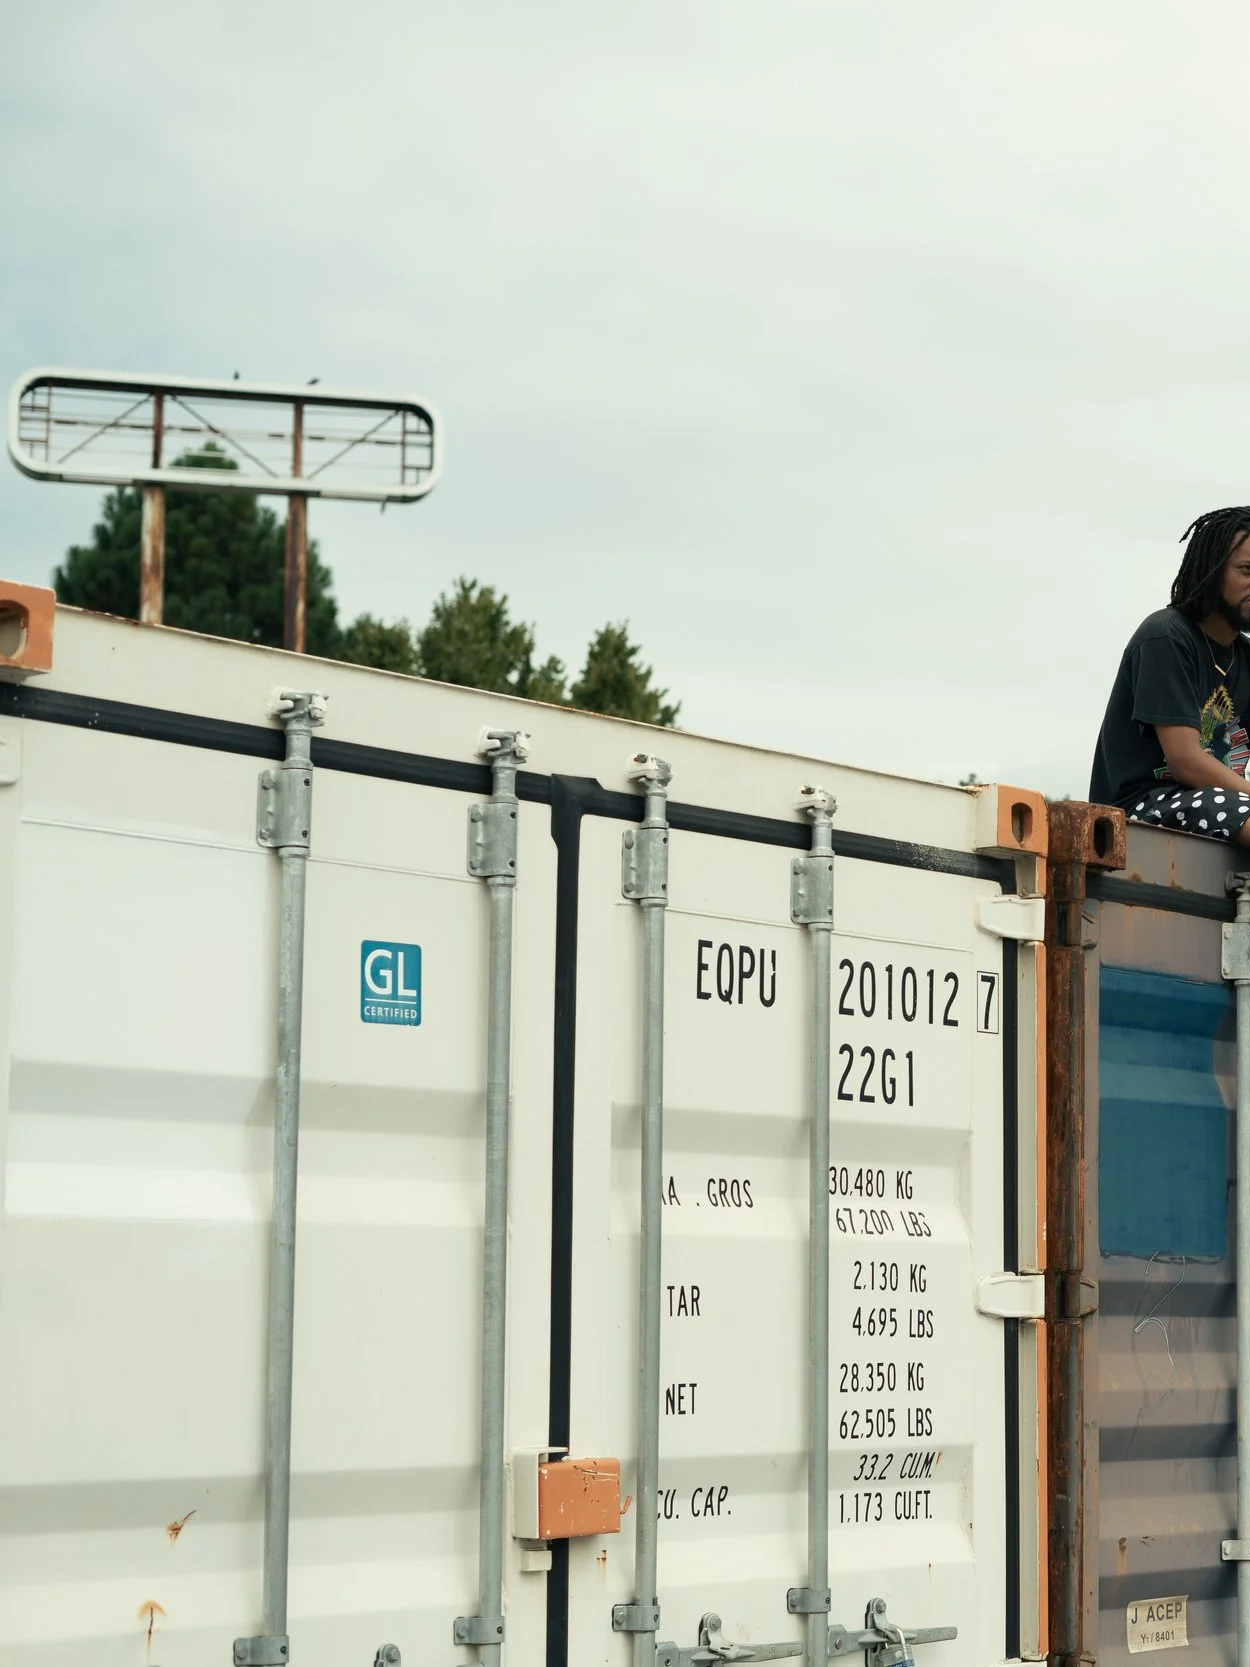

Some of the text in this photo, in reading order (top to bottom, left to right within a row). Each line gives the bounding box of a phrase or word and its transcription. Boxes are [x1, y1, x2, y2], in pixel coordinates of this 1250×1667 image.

[364, 948, 417, 997] GL
[696, 939, 996, 1031] EQPU 201012 7
[364, 1005, 418, 1019] CERTIFIED
[837, 1043, 914, 1107] 22G1
[828, 1165, 885, 1198] 30,480
[896, 1170, 913, 1200] KG
[899, 1210, 932, 1238] LBS
[853, 1260, 927, 1293] 2,130 KG
[852, 1306, 898, 1337] 4,695
[908, 1308, 934, 1339] LBS
[839, 1361, 925, 1393] 28,350 KG
[665, 1383, 933, 1440] NET 62,505 LBS
[853, 1453, 894, 1481] 33.2
[691, 1485, 731, 1518] CAP.
[839, 1491, 883, 1524] 1,173
[894, 1489, 933, 1521] CU.FT.
[1131, 1602, 1183, 1625] J ACEP
